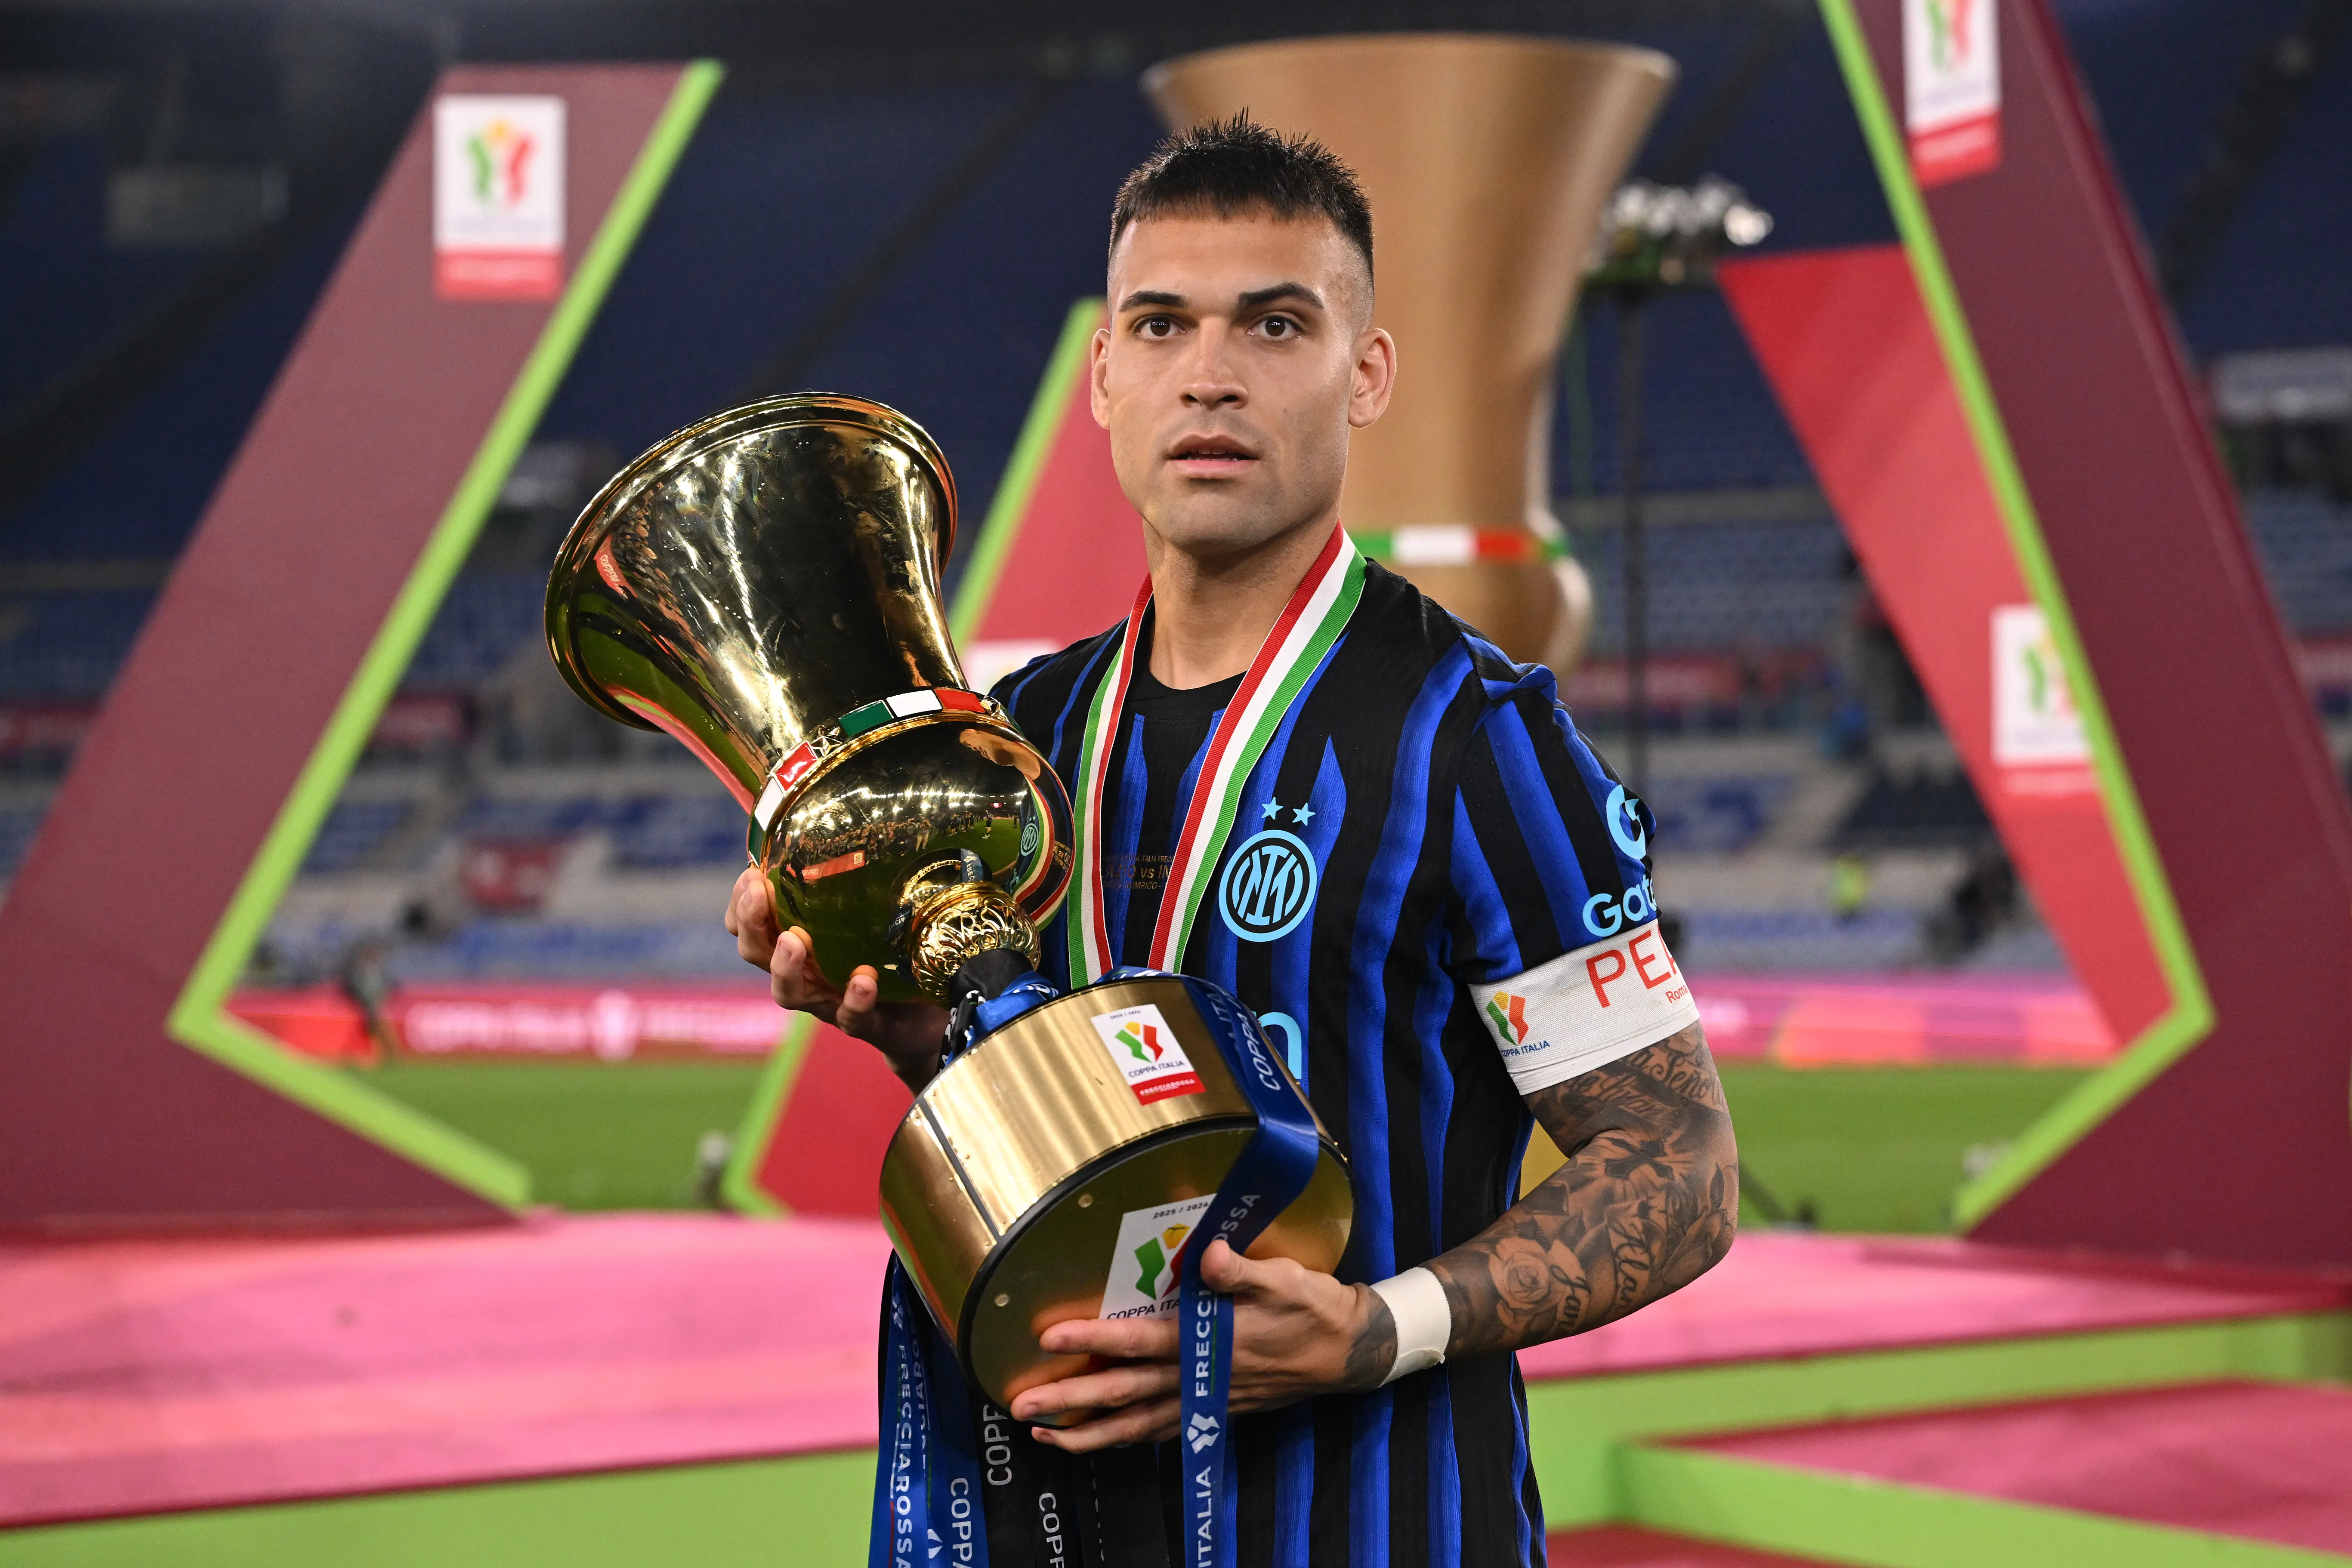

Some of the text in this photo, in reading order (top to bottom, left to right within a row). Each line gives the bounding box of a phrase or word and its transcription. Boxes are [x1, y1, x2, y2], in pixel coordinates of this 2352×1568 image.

[1236, 1012, 1281, 1091] COPPA
[1501, 1040, 1550, 1057] COPPA ITALIA
[1128, 1060, 1185, 1078] COPPA ITALIA
[1139, 1078, 1196, 1096] FRECCIAROSSA
[1153, 1208, 1176, 1219] 2025
[1186, 1201, 1208, 1212] 2026
[1107, 1303, 1155, 1320] COPPA
[1196, 1465, 1212, 1568] ITALIA
